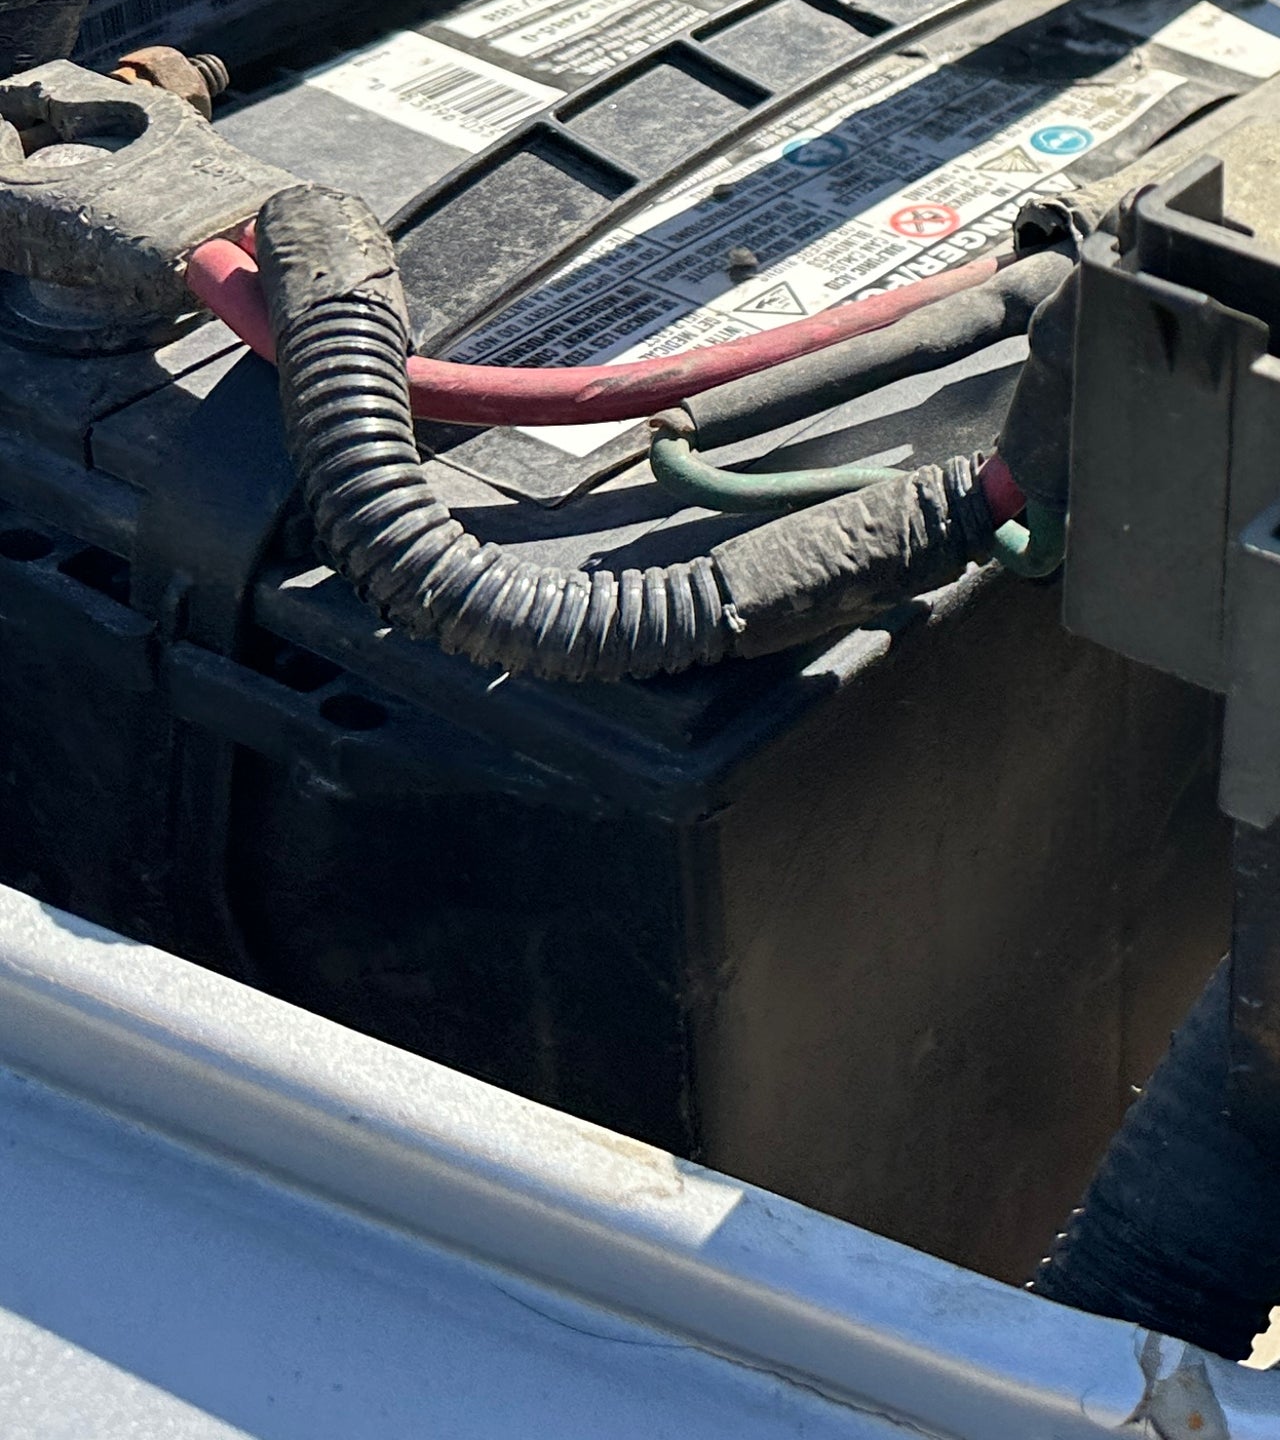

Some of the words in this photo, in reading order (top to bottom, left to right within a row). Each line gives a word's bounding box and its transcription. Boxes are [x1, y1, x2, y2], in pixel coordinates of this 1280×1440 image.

[803, 229, 875, 268] BLINDNESS
[857, 236, 891, 253] CAN
[634, 247, 664, 262] DO
[821, 250, 867, 275] CAUSE
[609, 257, 644, 276] NOT
[575, 272, 619, 295] OPEN
[822, 272, 859, 291] ACID
[528, 289, 554, 302] LA
[494, 323, 524, 339] DO
[689, 315, 722, 333] GET
[465, 335, 502, 354] NOT
[587, 332, 621, 349] LES
